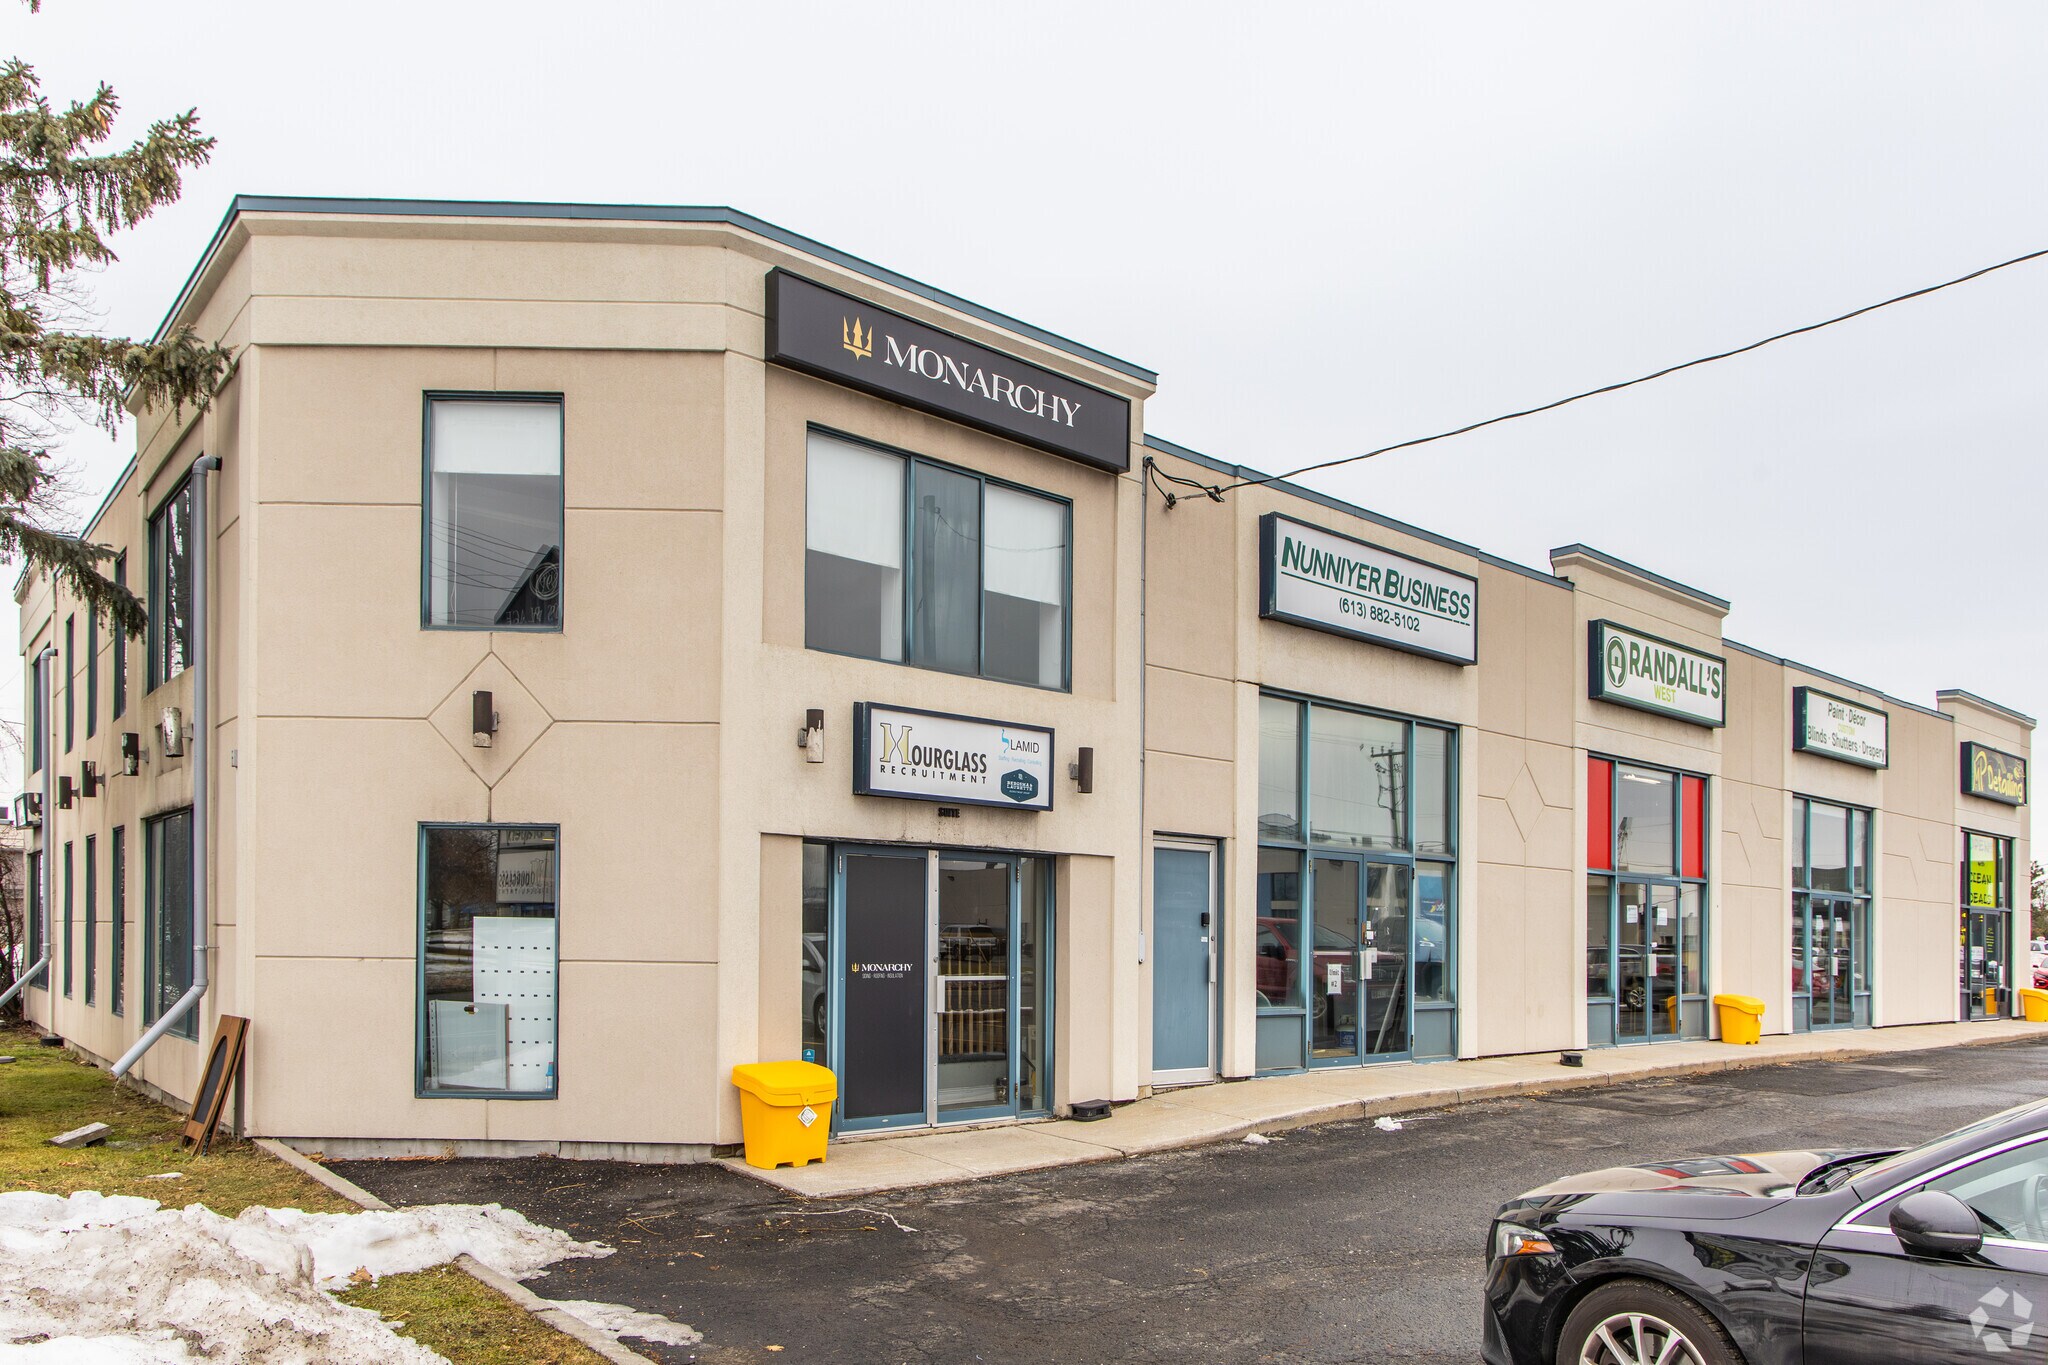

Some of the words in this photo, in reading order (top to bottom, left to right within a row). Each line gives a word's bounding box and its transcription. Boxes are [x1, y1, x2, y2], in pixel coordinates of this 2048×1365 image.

[884, 334, 1081, 428] MONARCHY
[1281, 536, 1381, 595] NUNNIYER
[1383, 568, 1470, 619] BUSINESS
[1339, 597, 1367, 619] (613)
[1370, 605, 1420, 632] 882-5102
[1629, 641, 1721, 699] RANDALL'S
[1654, 684, 1676, 703] WEST
[1828, 702, 1845, 721] Paint
[1010, 739, 1040, 754] LAMID
[1807, 724, 1827, 744] Blinds
[1831, 732, 1858, 753] Shutters
[1861, 741, 1885, 762] Drapery
[879, 764, 987, 785] RECRUITMENT
[861, 963, 913, 971] MONARCHY
